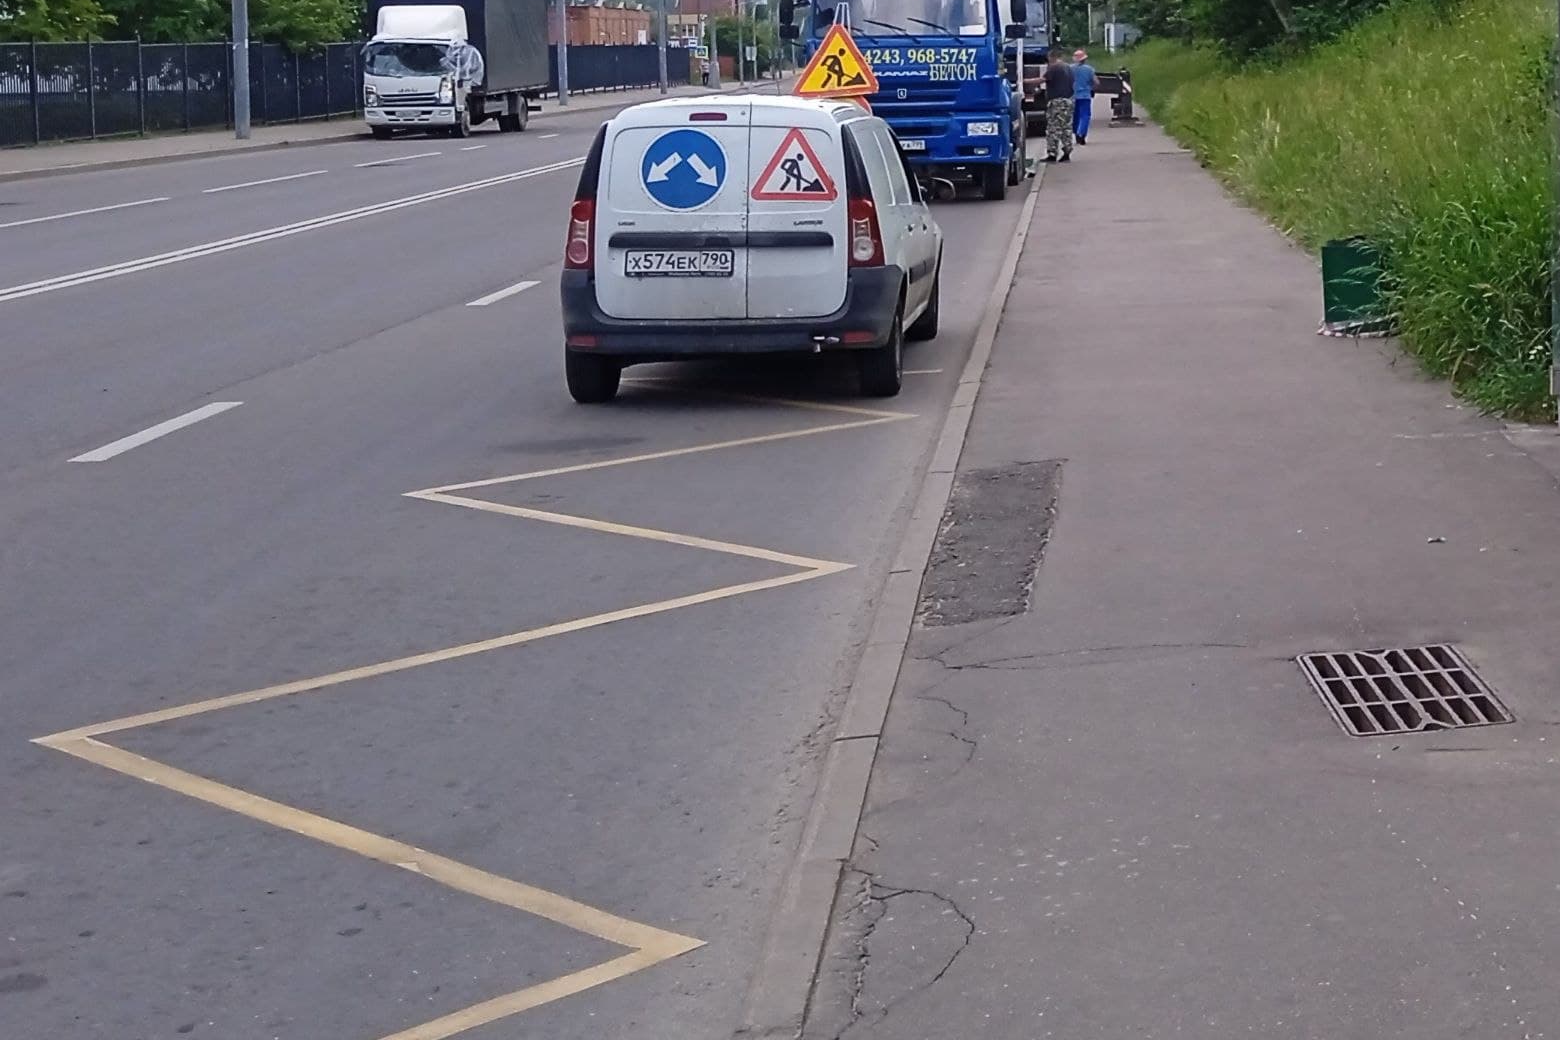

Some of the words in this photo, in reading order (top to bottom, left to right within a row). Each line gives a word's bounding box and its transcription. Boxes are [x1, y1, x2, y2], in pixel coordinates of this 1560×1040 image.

[907, 48, 977, 64] 968-5747
[929, 64, 977, 81] БЕТОН
[701, 252, 728, 266] 790
